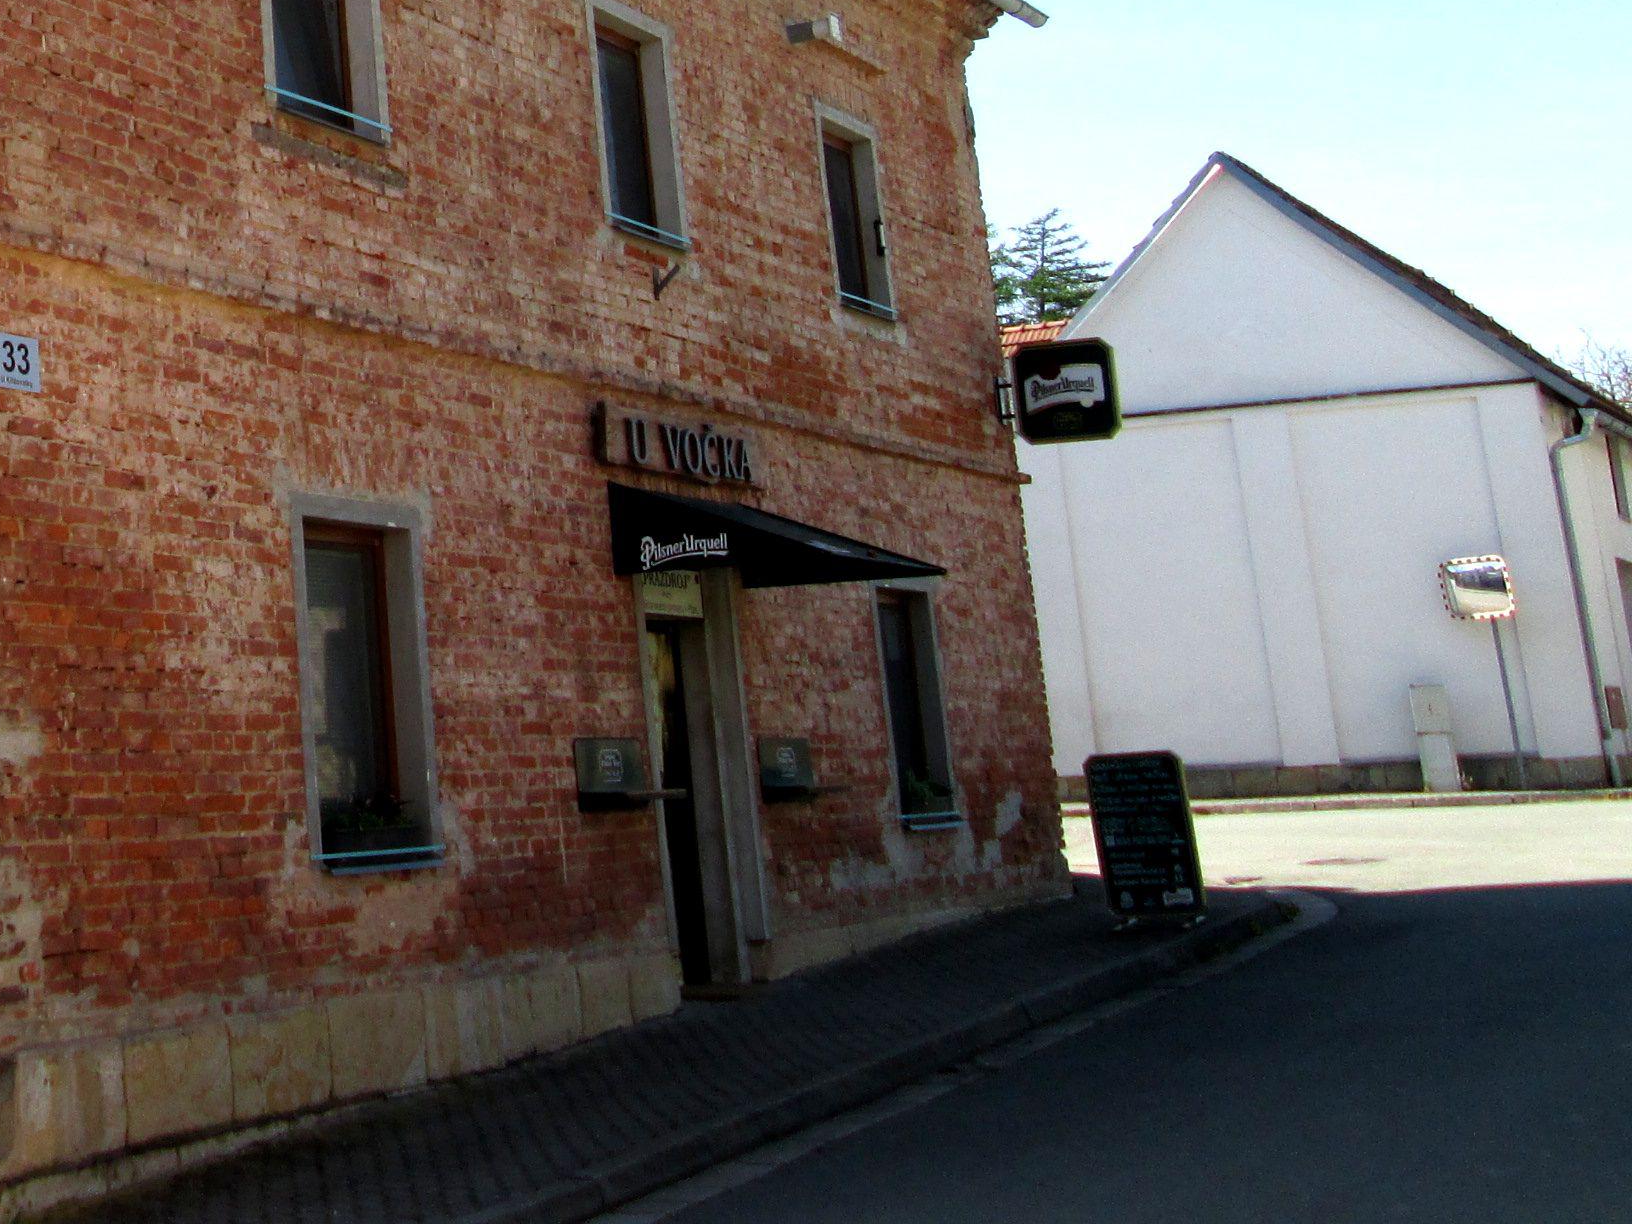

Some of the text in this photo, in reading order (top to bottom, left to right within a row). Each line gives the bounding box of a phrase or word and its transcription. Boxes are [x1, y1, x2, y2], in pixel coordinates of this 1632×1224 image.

[2, 340, 31, 375] 33
[626, 418, 648, 464] U
[640, 532, 729, 571] Pilsner Urquell
